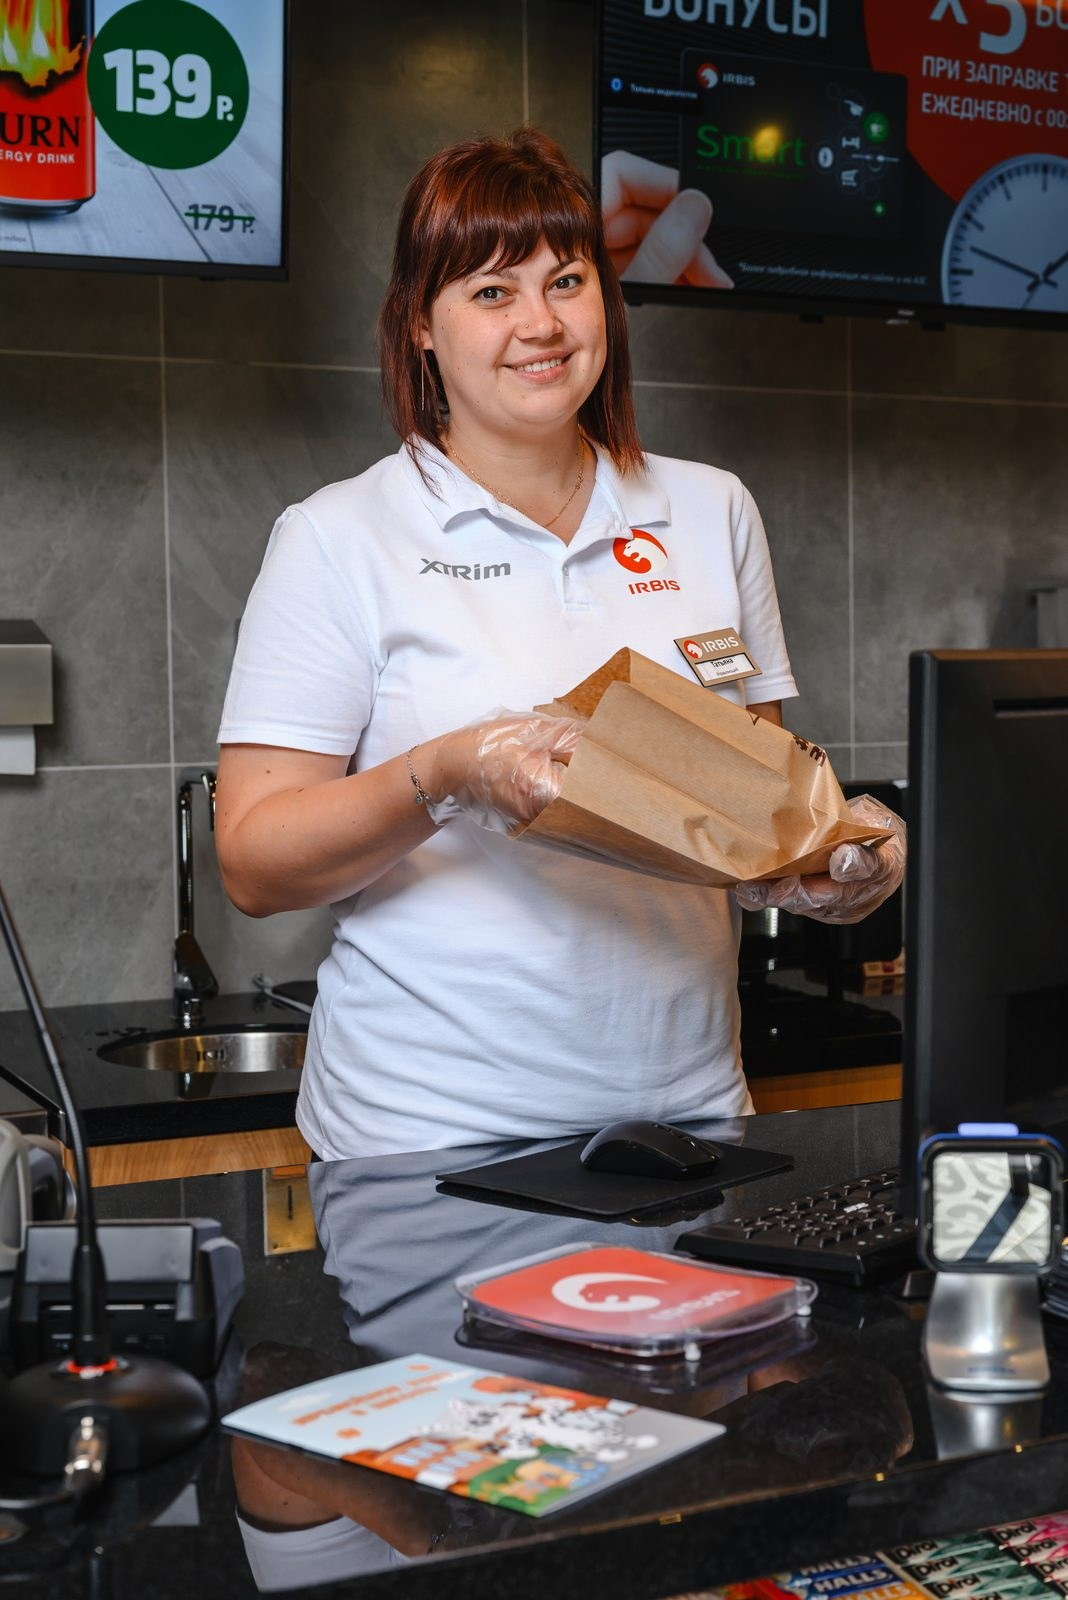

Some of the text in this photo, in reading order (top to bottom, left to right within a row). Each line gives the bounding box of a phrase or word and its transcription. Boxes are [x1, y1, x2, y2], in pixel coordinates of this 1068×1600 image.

[103, 48, 212, 119] 139
[722, 73, 756, 86] IRBIS
[922, 55, 960, 81] ПРИ
[965, 60, 1059, 92] ЗАПРАВКЕ
[921, 92, 1031, 125] ЕЖЕДНЕВНО
[37, 153, 75, 164] DRINK
[188, 203, 235, 233] 179
[628, 579, 681, 595] IRBIS
[701, 636, 739, 653] IRBIS
[915, 1556, 959, 1577] Dirol
[936, 1574, 981, 1595] Dirol
